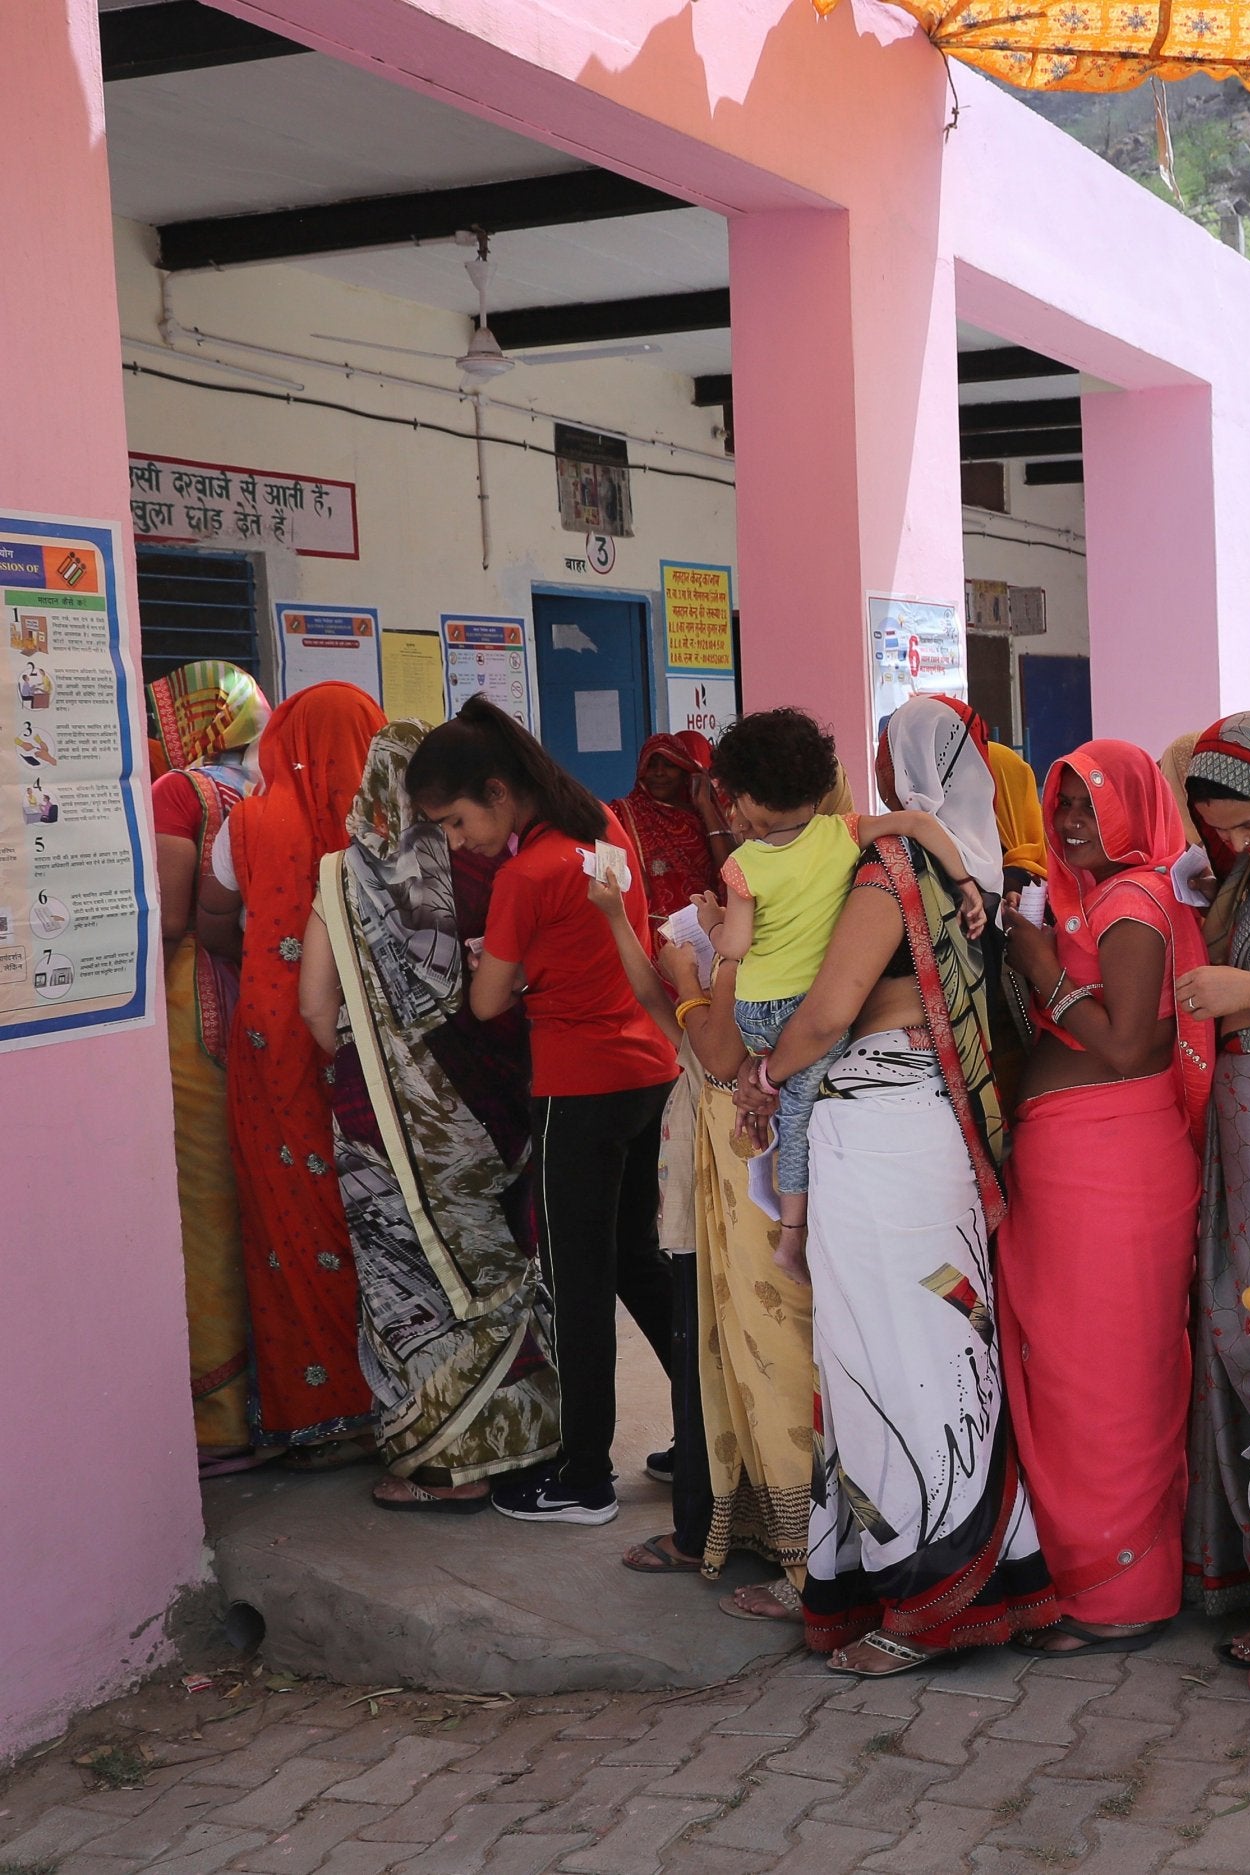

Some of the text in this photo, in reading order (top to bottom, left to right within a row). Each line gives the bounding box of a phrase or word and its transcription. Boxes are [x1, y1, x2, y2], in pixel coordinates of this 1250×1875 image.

[171, 470, 232, 500] दरवाजे
[239, 474, 259, 505] से
[264, 478, 304, 511] आती
[233, 501, 262, 539] देते
[595, 537, 609, 567] 3
[26, 564, 39, 573] OF
[564, 558, 587, 573] बाहर
[13, 608, 19, 622] 1
[26, 661, 38, 676] 2
[23, 721, 33, 737] 3
[687, 714, 716, 730] Hero
[33, 777, 42, 791] 4
[34, 836, 45, 852] 5
[38, 889, 48, 904] 6
[43, 949, 52, 964] 7
